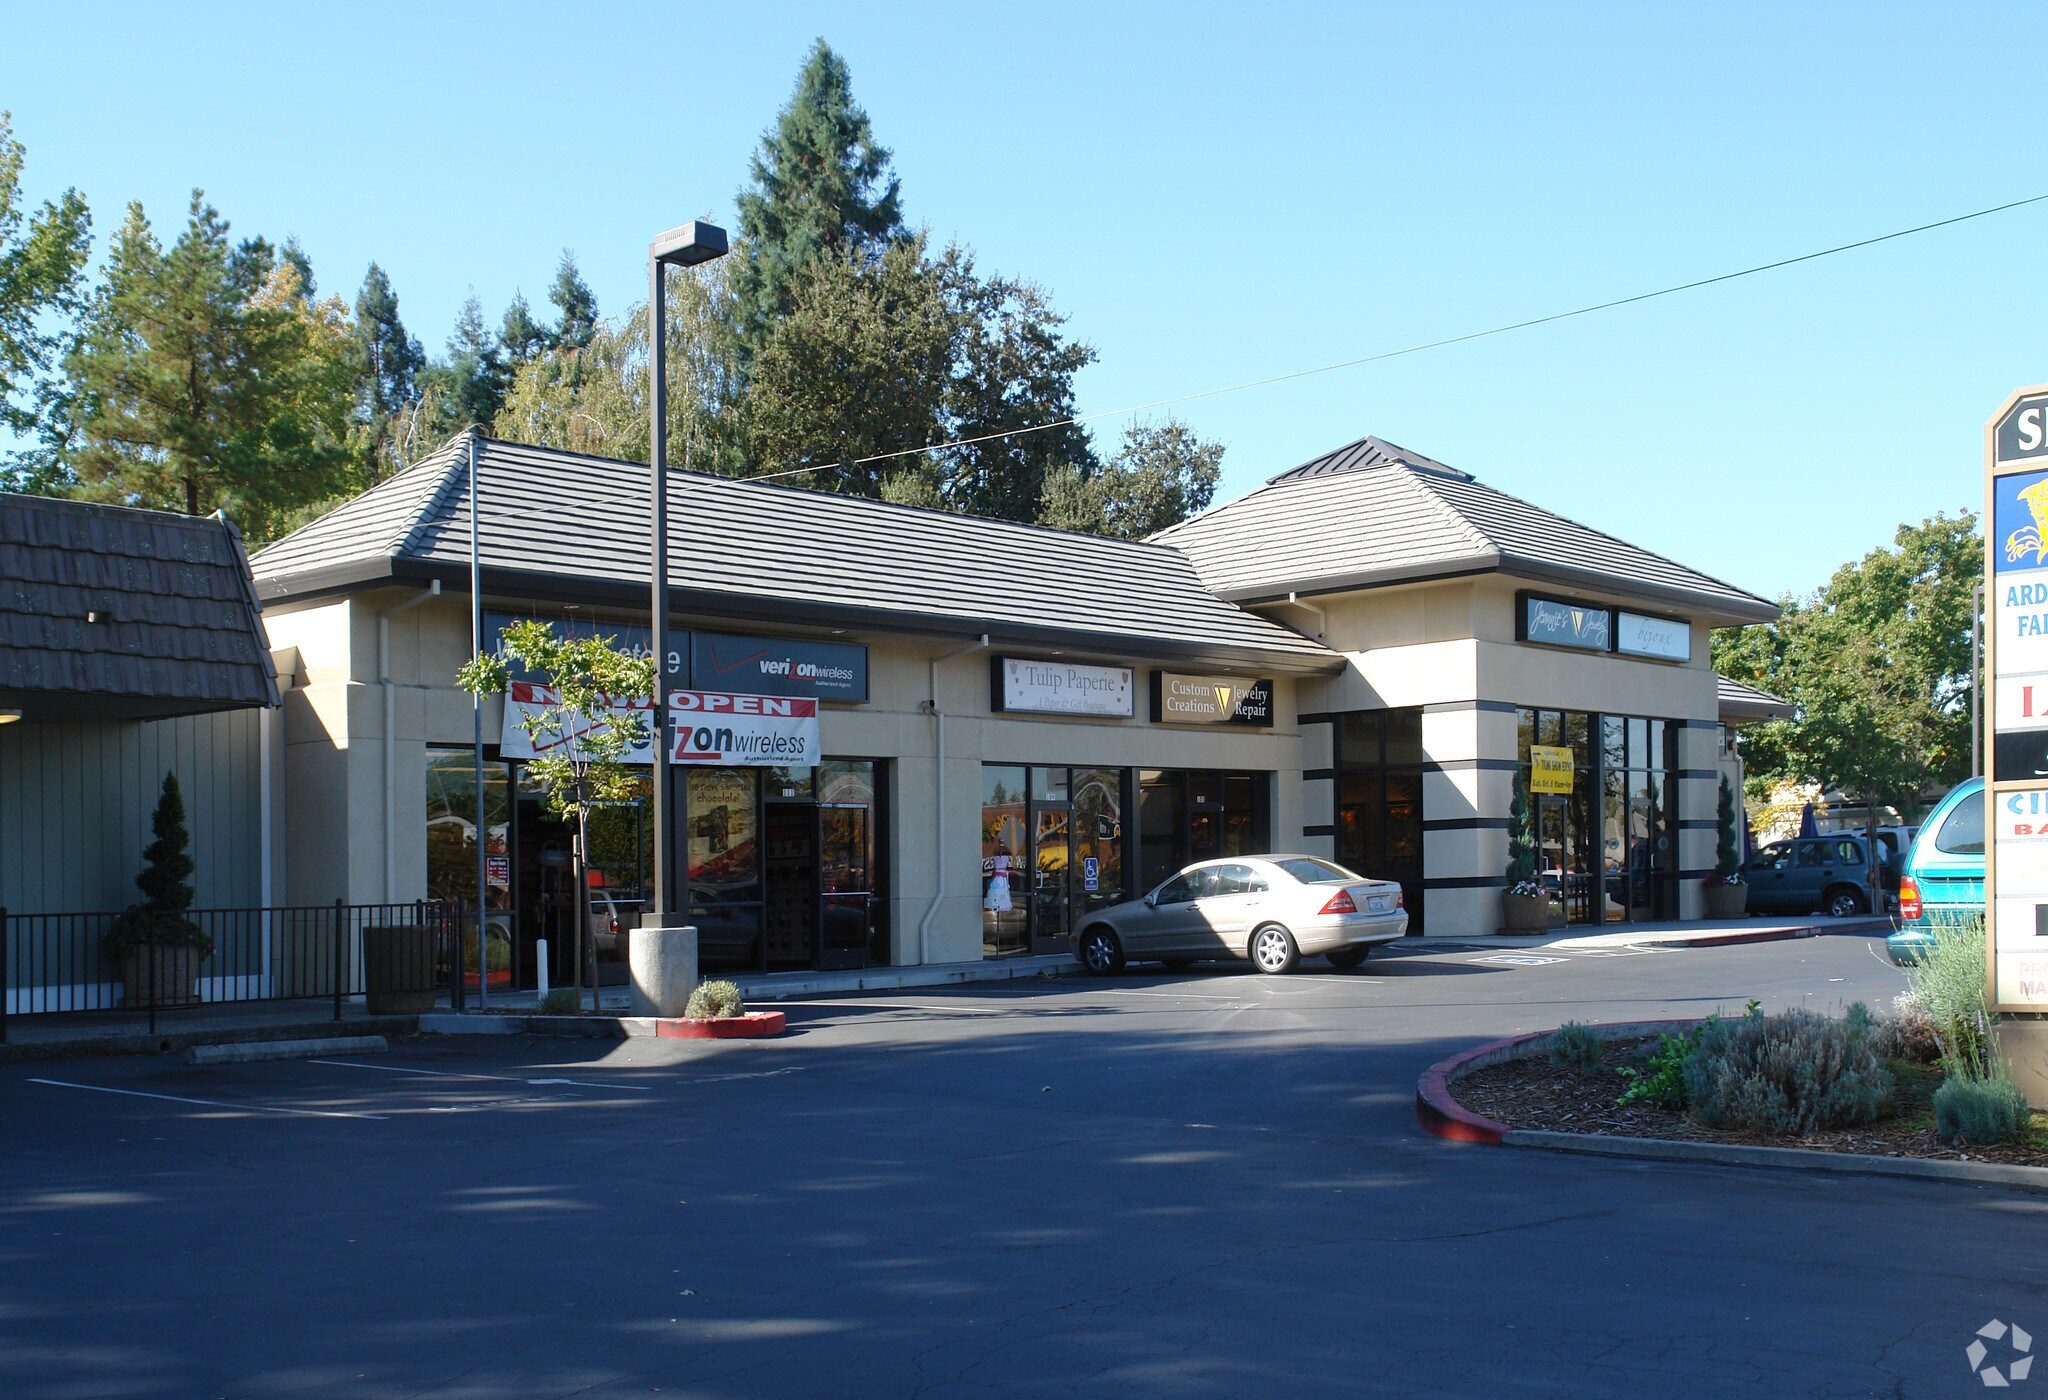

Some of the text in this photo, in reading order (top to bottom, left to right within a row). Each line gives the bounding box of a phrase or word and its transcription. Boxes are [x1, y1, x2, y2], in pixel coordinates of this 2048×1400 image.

[2018, 407, 2048, 451] S
[1026, 666, 1115, 696] Tulip Paperie
[1171, 680, 1210, 696] Custom
[1233, 684, 1268, 704] Jewelry
[668, 693, 792, 717] OPEN
[1167, 696, 1215, 714] Creations
[1235, 701, 1266, 720] Repair
[2007, 792, 2048, 815] CI
